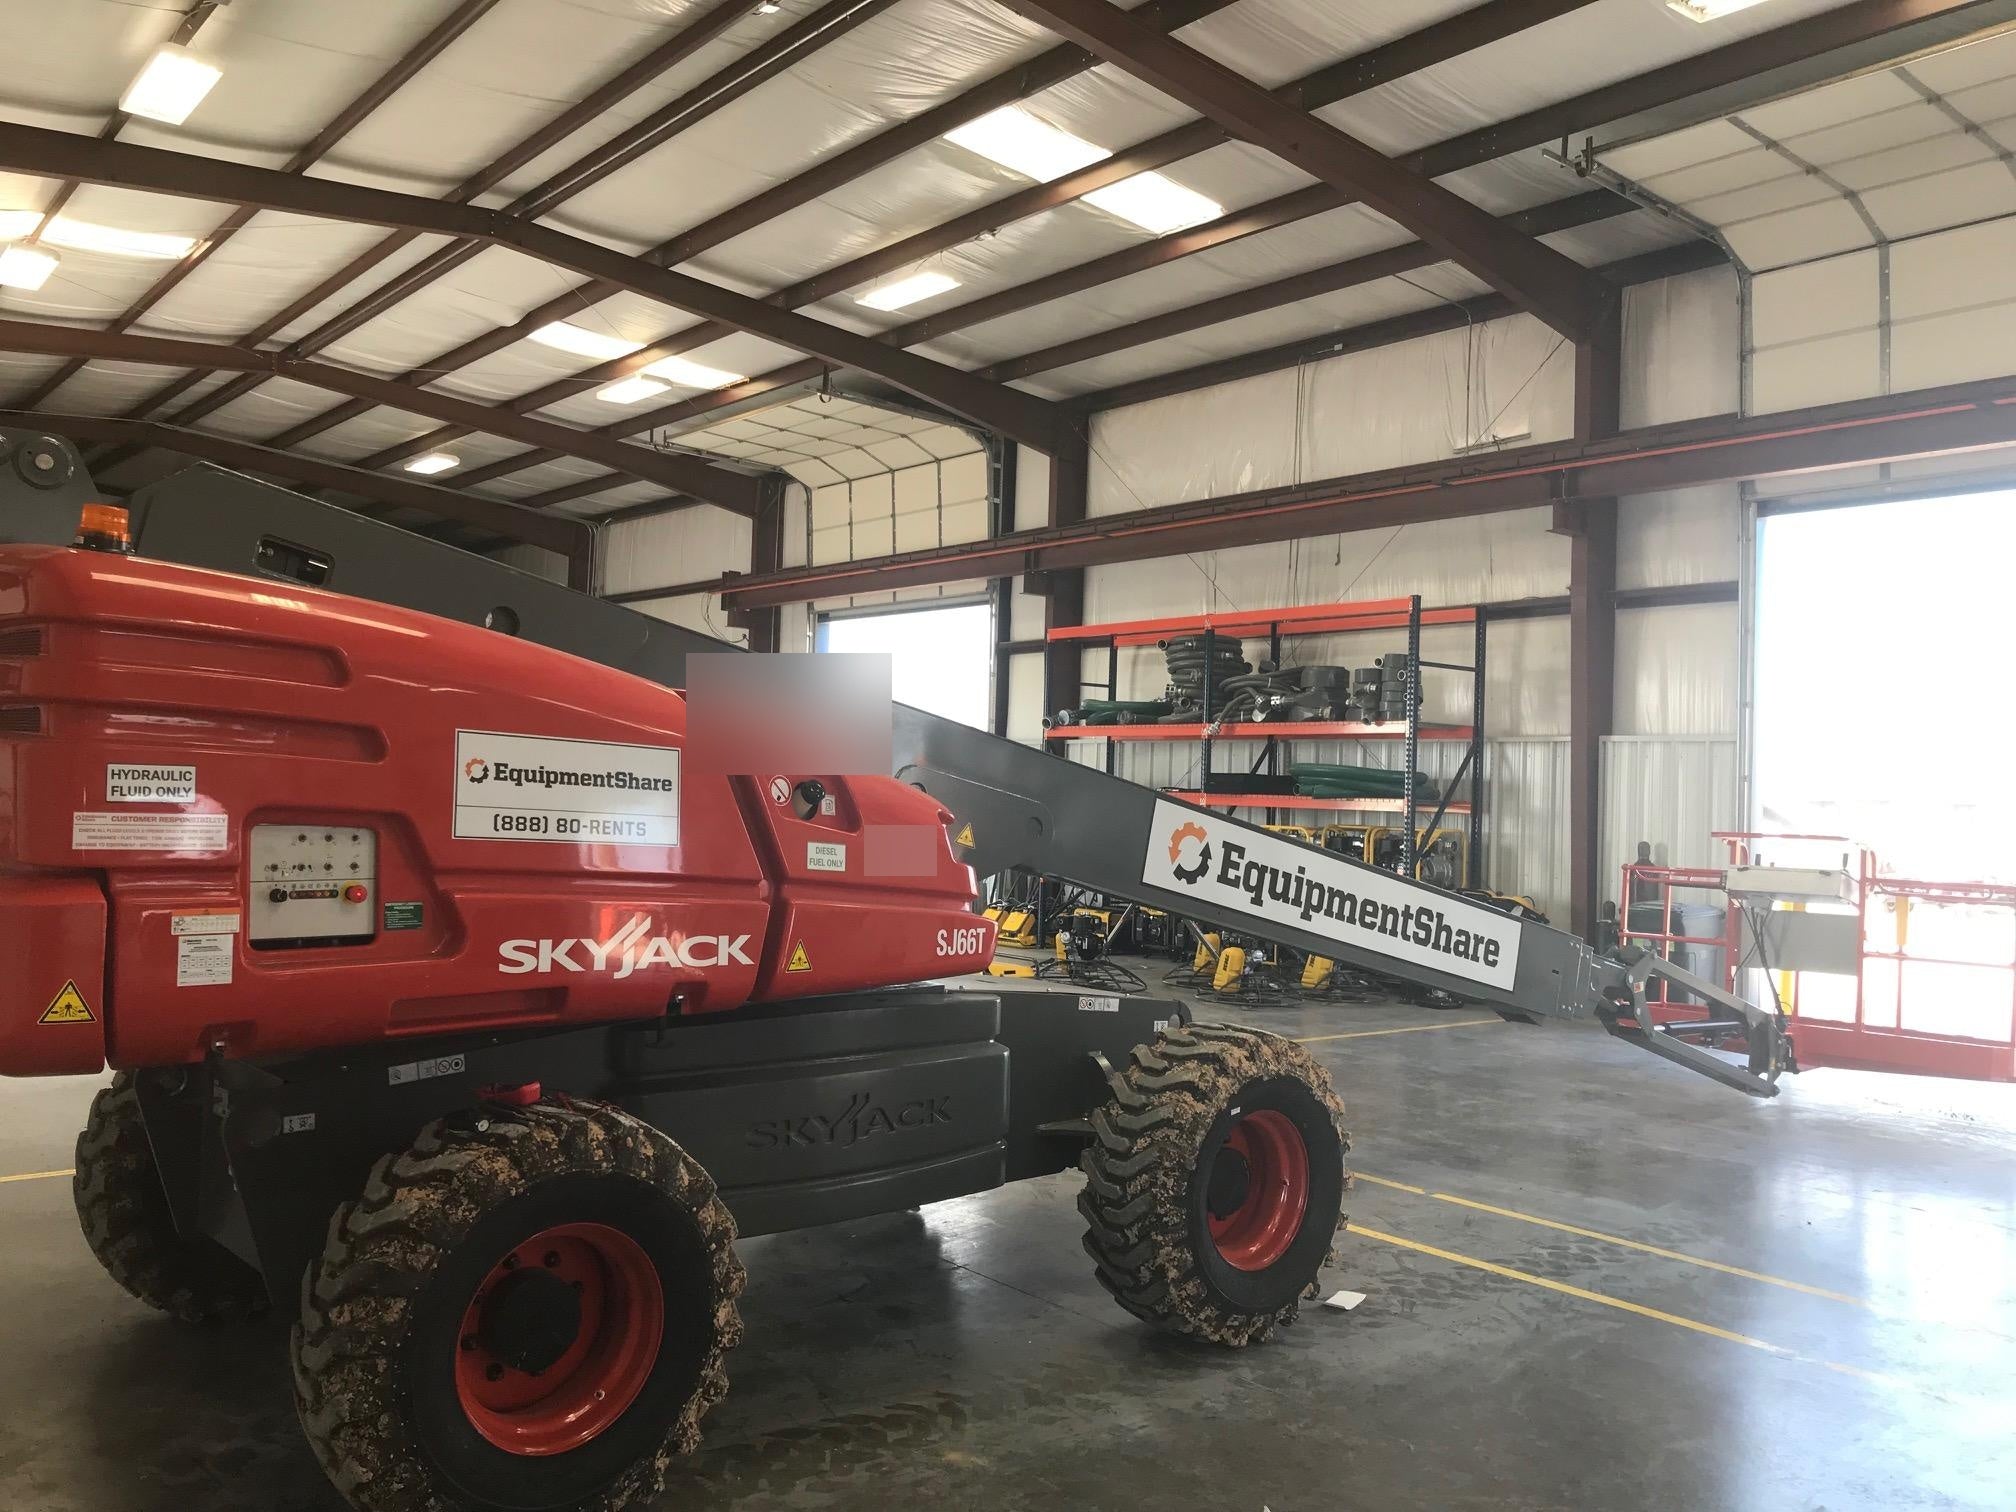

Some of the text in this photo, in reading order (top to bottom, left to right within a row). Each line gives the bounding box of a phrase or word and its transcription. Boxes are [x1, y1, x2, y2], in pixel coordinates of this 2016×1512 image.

[111, 769, 193, 782] HYDRAULIC
[493, 762, 673, 792] EquipmentShare
[111, 785, 192, 798] FLUID ONLY
[111, 815, 157, 823] CUSTOMER
[493, 813, 647, 837] (888) 80-RENTS
[809, 857, 844, 868] FUEL ONLY
[815, 846, 838, 856] DIESEL
[1216, 840, 1501, 968] EquipmentShare
[498, 915, 755, 980] SKYJACK
[936, 927, 987, 957] SJ66T
[746, 1091, 952, 1149] SKYJACK
